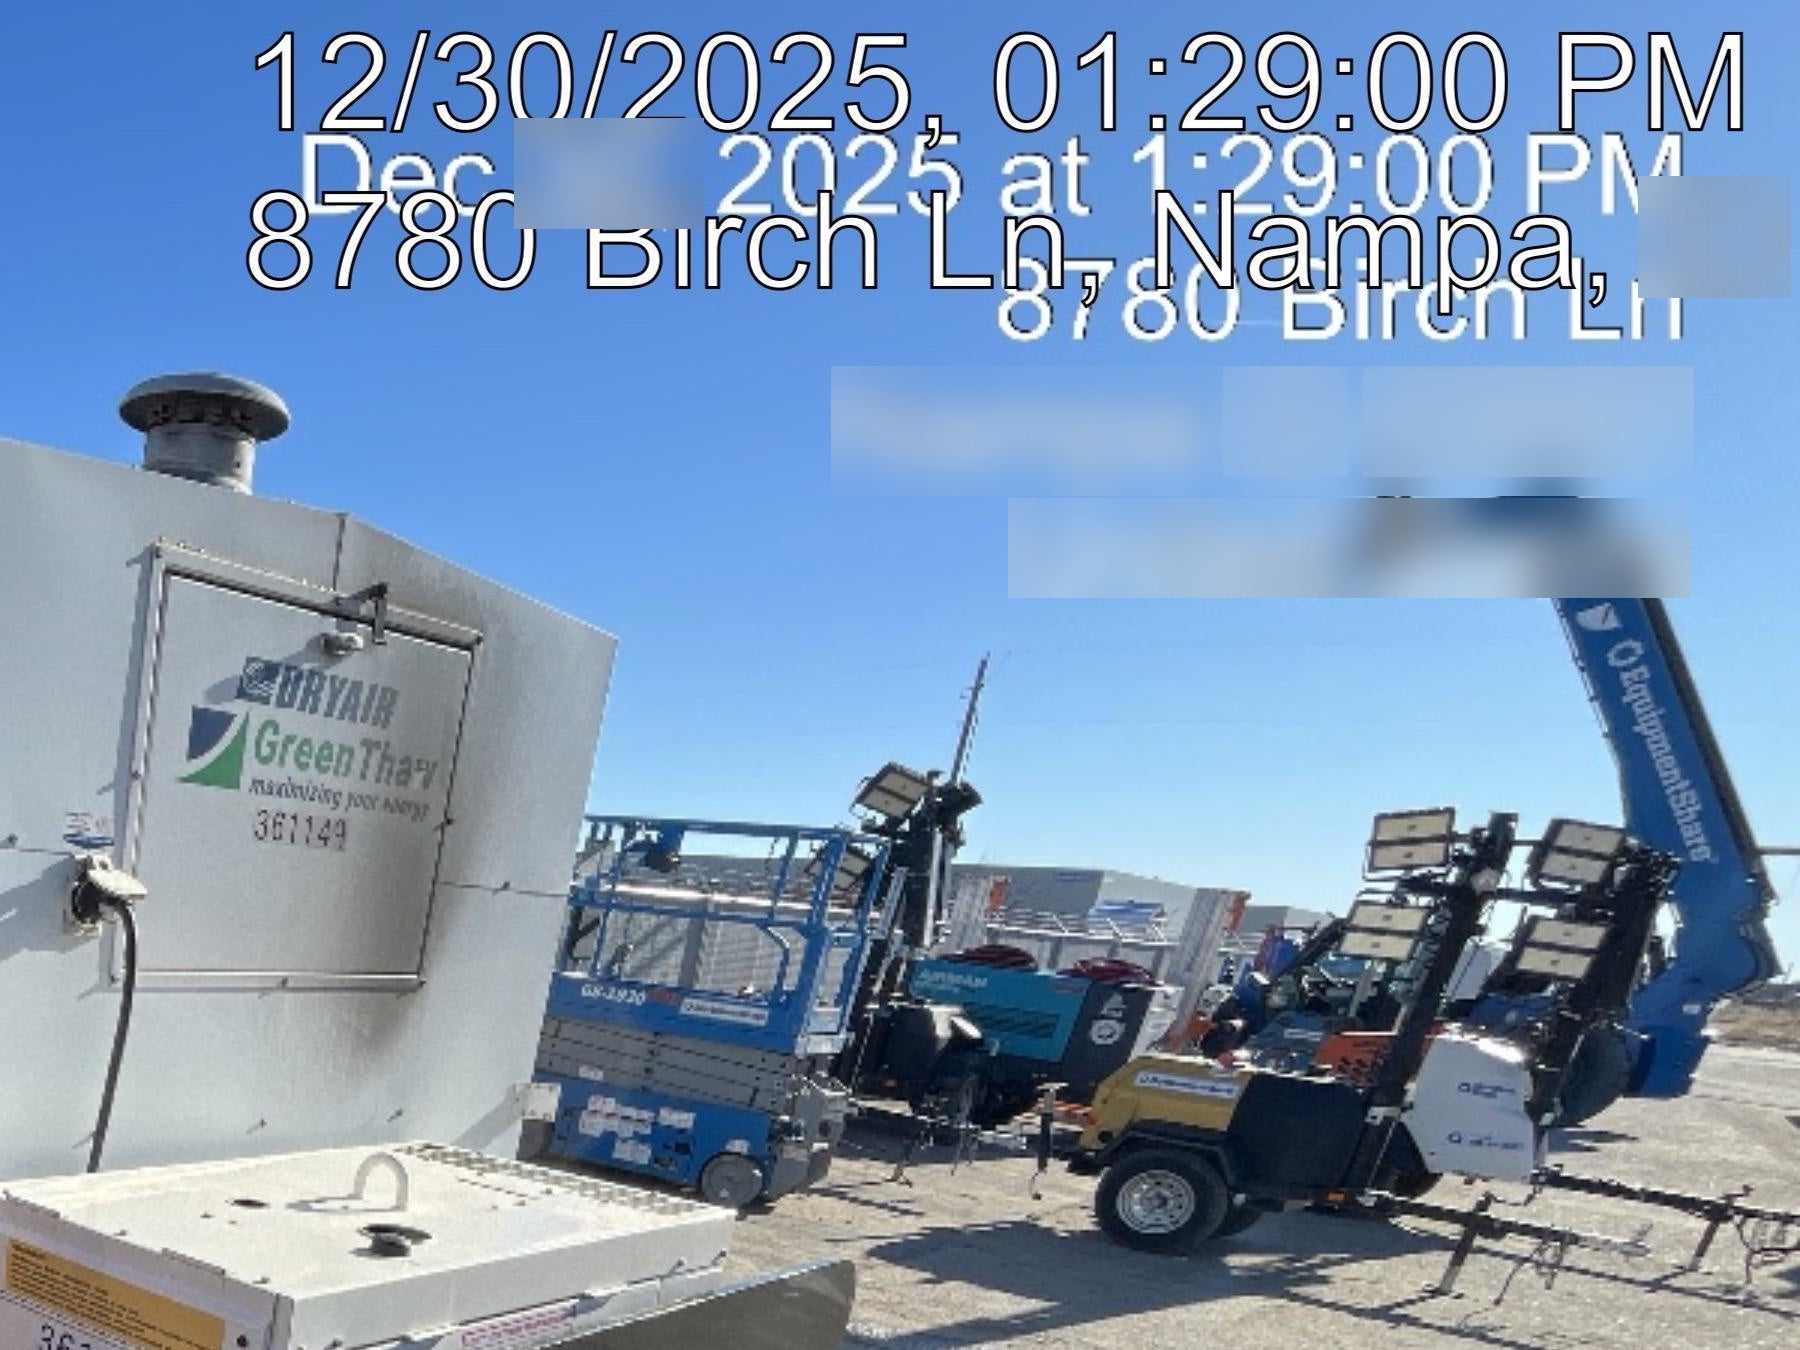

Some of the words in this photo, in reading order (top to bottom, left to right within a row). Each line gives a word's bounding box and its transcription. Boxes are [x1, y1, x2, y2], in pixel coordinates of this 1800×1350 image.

[275, 664, 399, 729] DRYAIR
[1618, 663, 1714, 864] EquipmentShare
[254, 809, 347, 849] 361149
